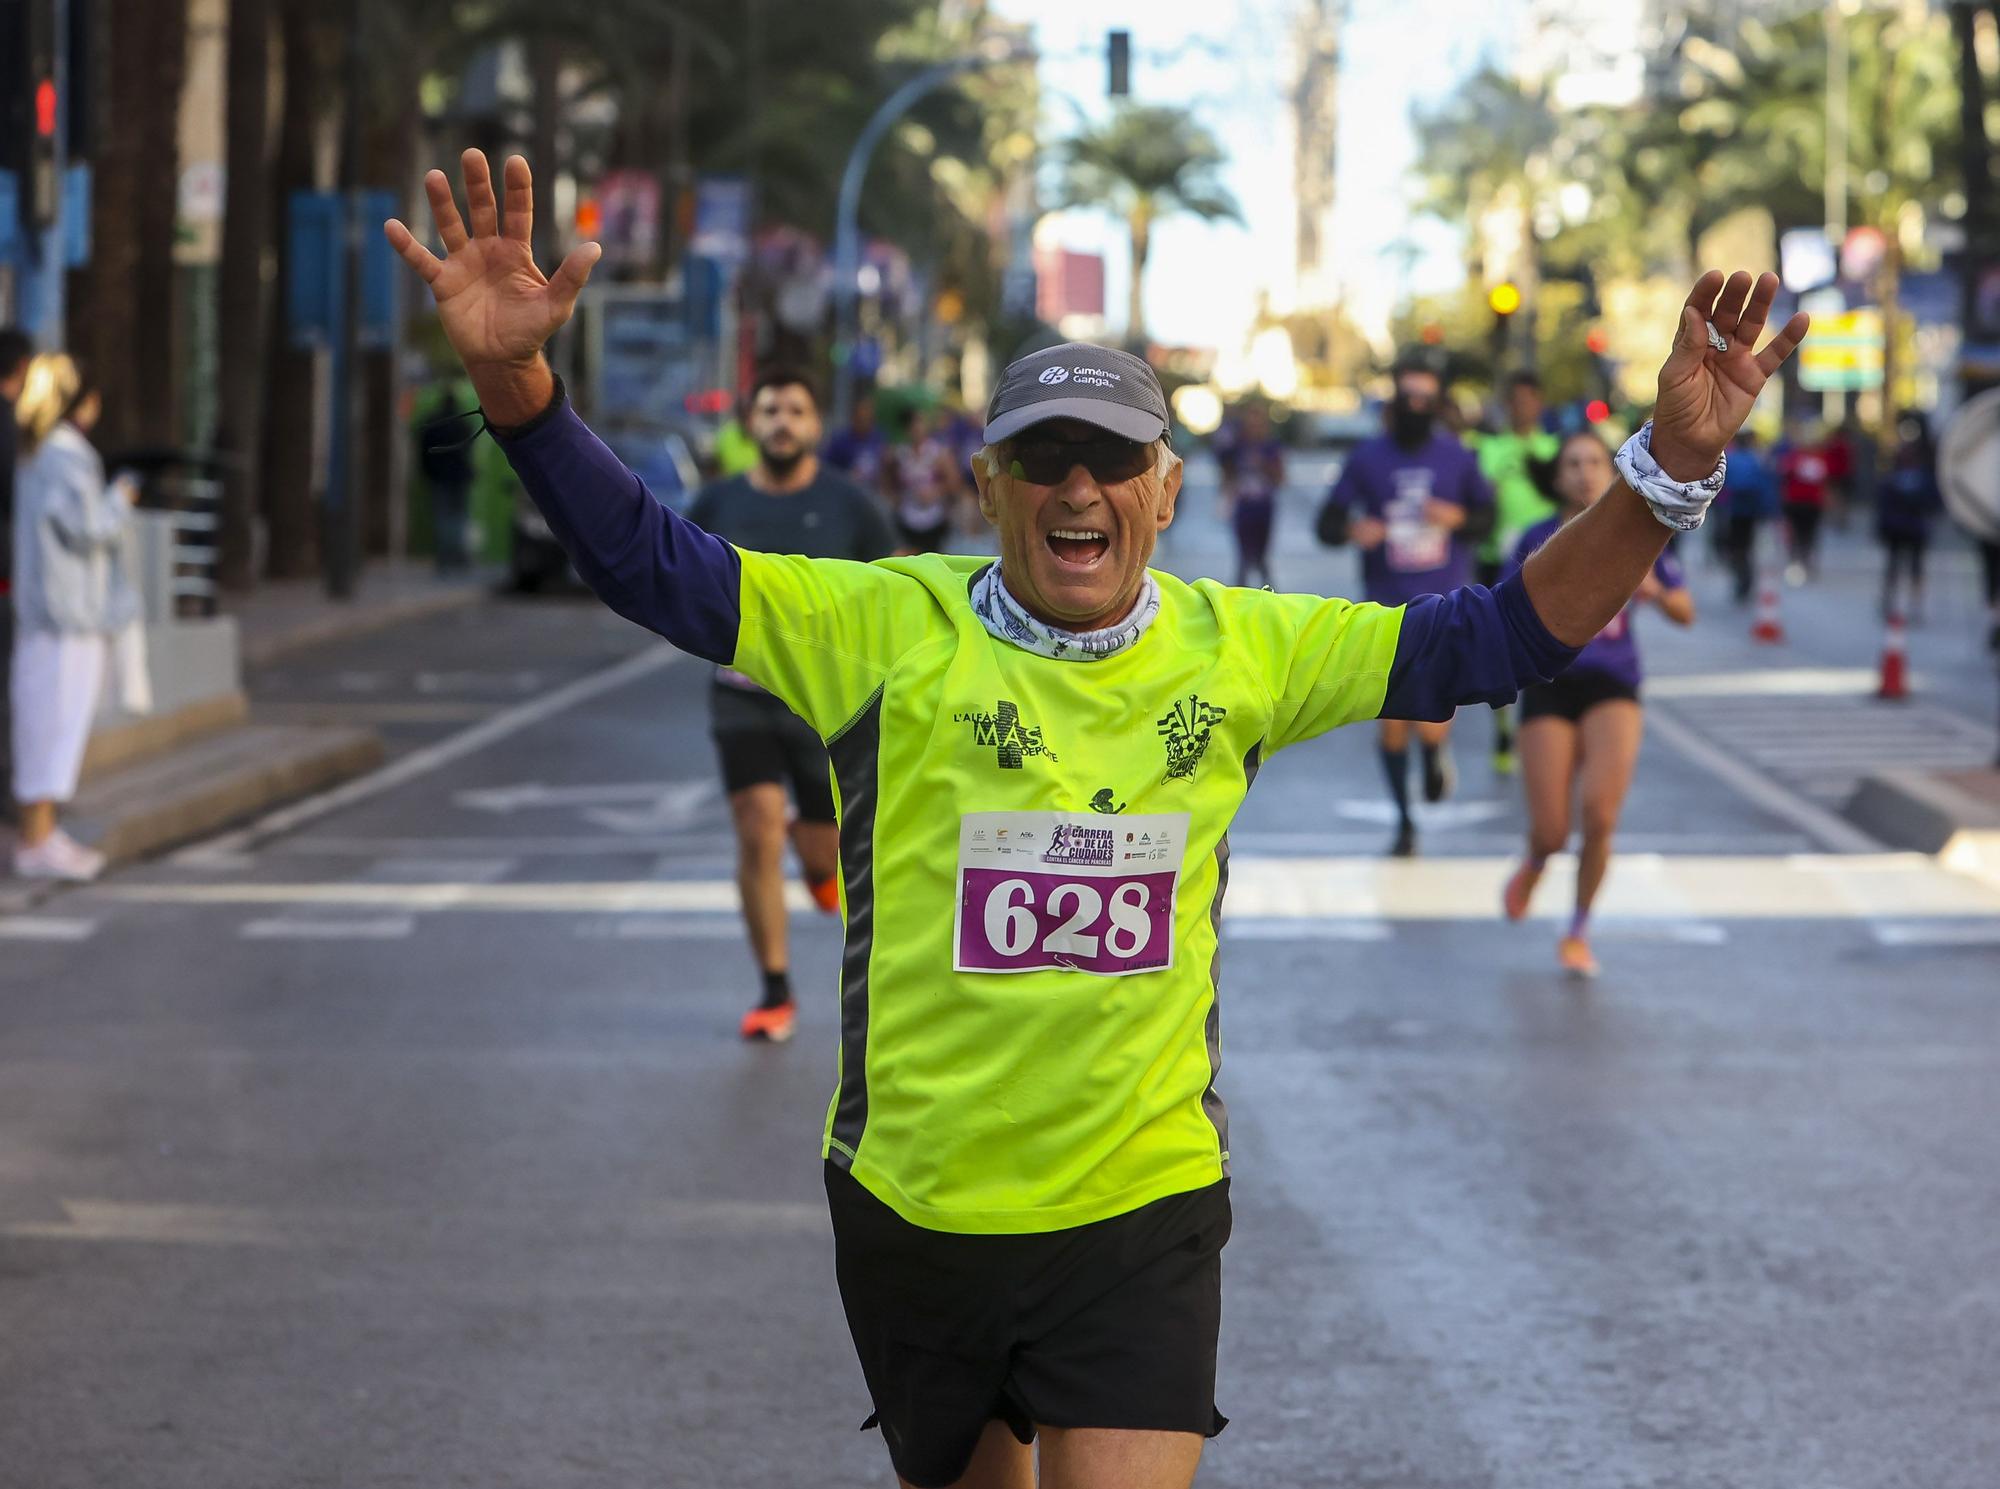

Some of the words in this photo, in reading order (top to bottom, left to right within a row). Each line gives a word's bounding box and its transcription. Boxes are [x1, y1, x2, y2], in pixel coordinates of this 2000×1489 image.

[1073, 366, 1121, 381] Giménez
[1073, 375, 1110, 387] Ganga
[974, 717, 1042, 749] MÁS
[1072, 828, 1113, 840] CARRERA
[1084, 838, 1096, 849] DE
[1097, 839, 1114, 850] LAS
[1069, 847, 1114, 860] CIUDADES
[984, 878, 1152, 958] 628
